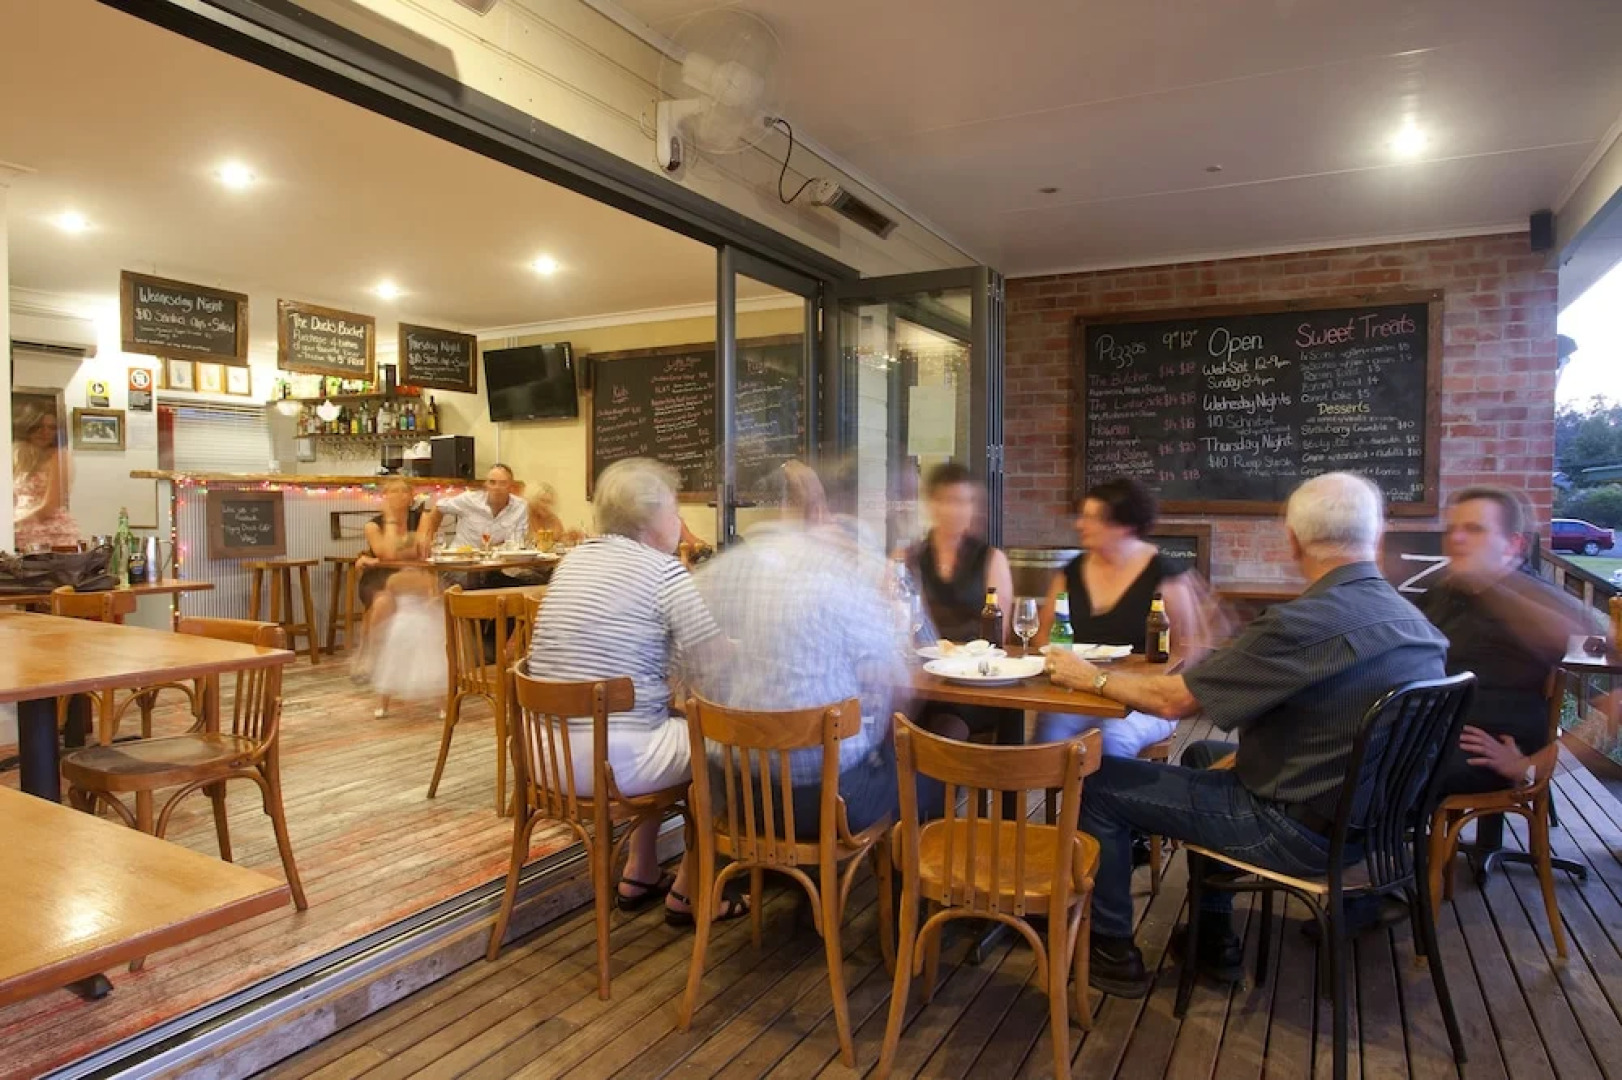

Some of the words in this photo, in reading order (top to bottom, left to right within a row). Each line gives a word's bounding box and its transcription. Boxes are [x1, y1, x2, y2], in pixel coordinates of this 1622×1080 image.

[196, 296, 224, 313] Night
[289, 312, 307, 329] The
[1295, 317, 1356, 348] Sweet
[1357, 312, 1416, 338] Treats
[1095, 333, 1147, 369] Pizzas
[1207, 326, 1263, 363] Open
[1207, 375, 1242, 392] Sunday
[1203, 393, 1256, 415] Wednesday
[1255, 391, 1292, 413] Nights
[1316, 400, 1371, 415] Desserts
[1198, 435, 1260, 456] Thursday
[1261, 433, 1293, 453] Night
[1208, 453, 1229, 468] $10
[1397, 553, 1452, 593] Z
